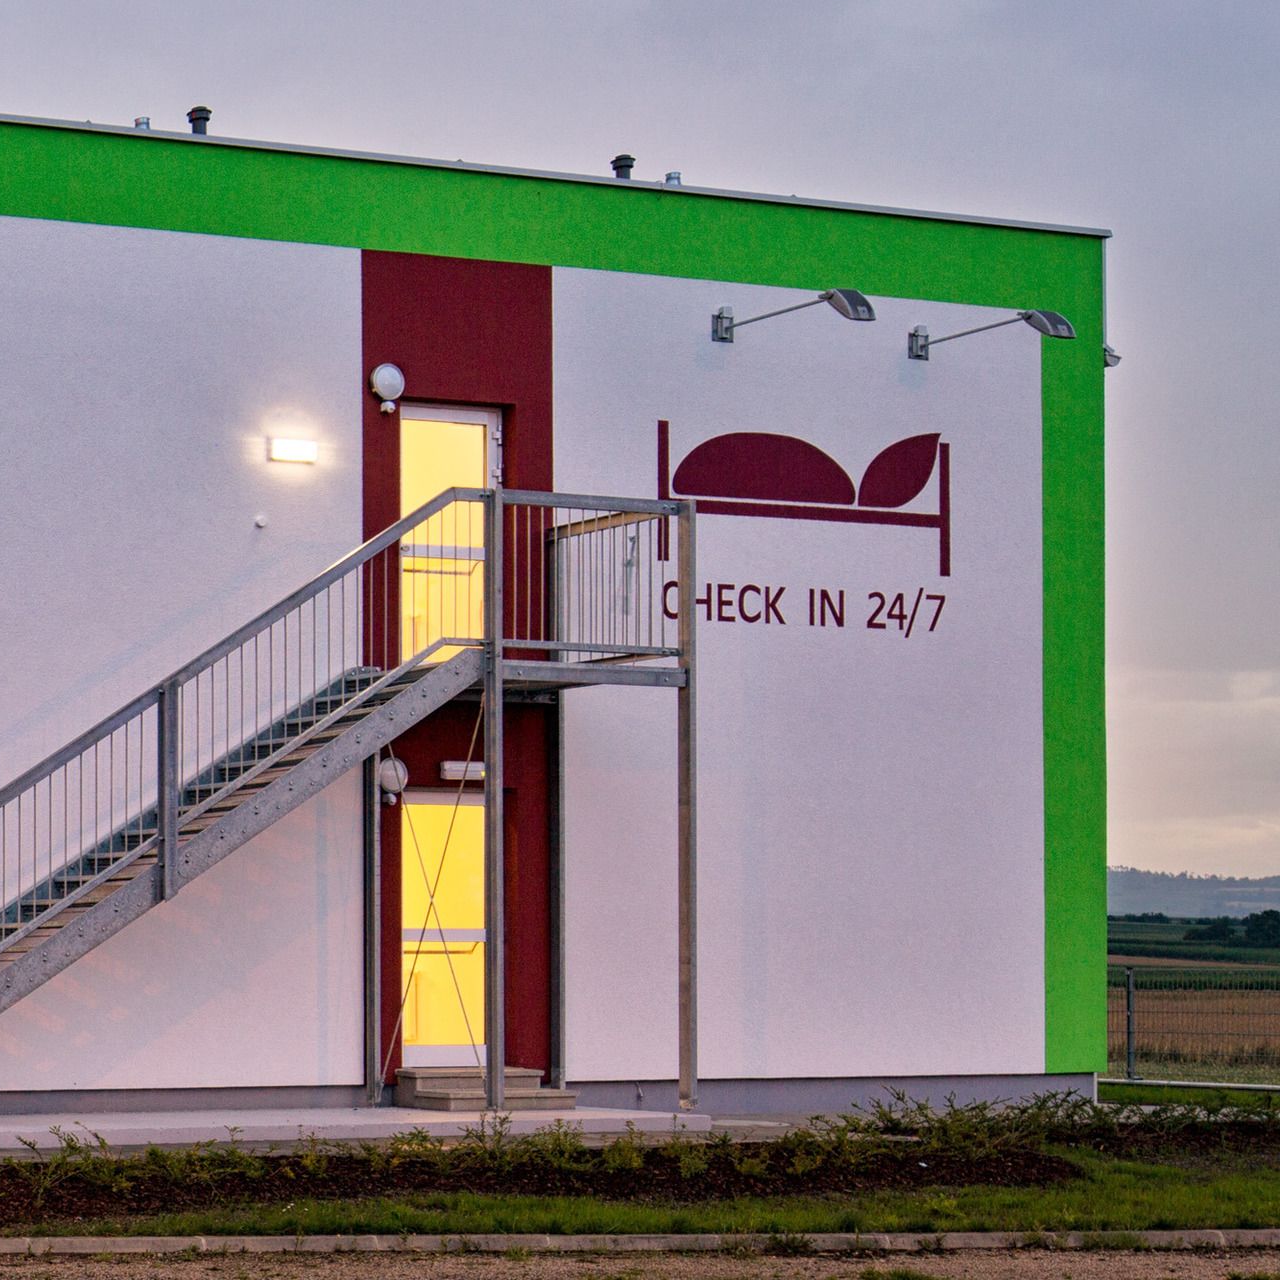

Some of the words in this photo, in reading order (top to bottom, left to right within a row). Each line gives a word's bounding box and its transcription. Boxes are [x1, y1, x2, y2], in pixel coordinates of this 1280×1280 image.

[661, 580, 786, 625] CHECK
[809, 588, 844, 628] IN
[866, 587, 947, 638] 24/7
